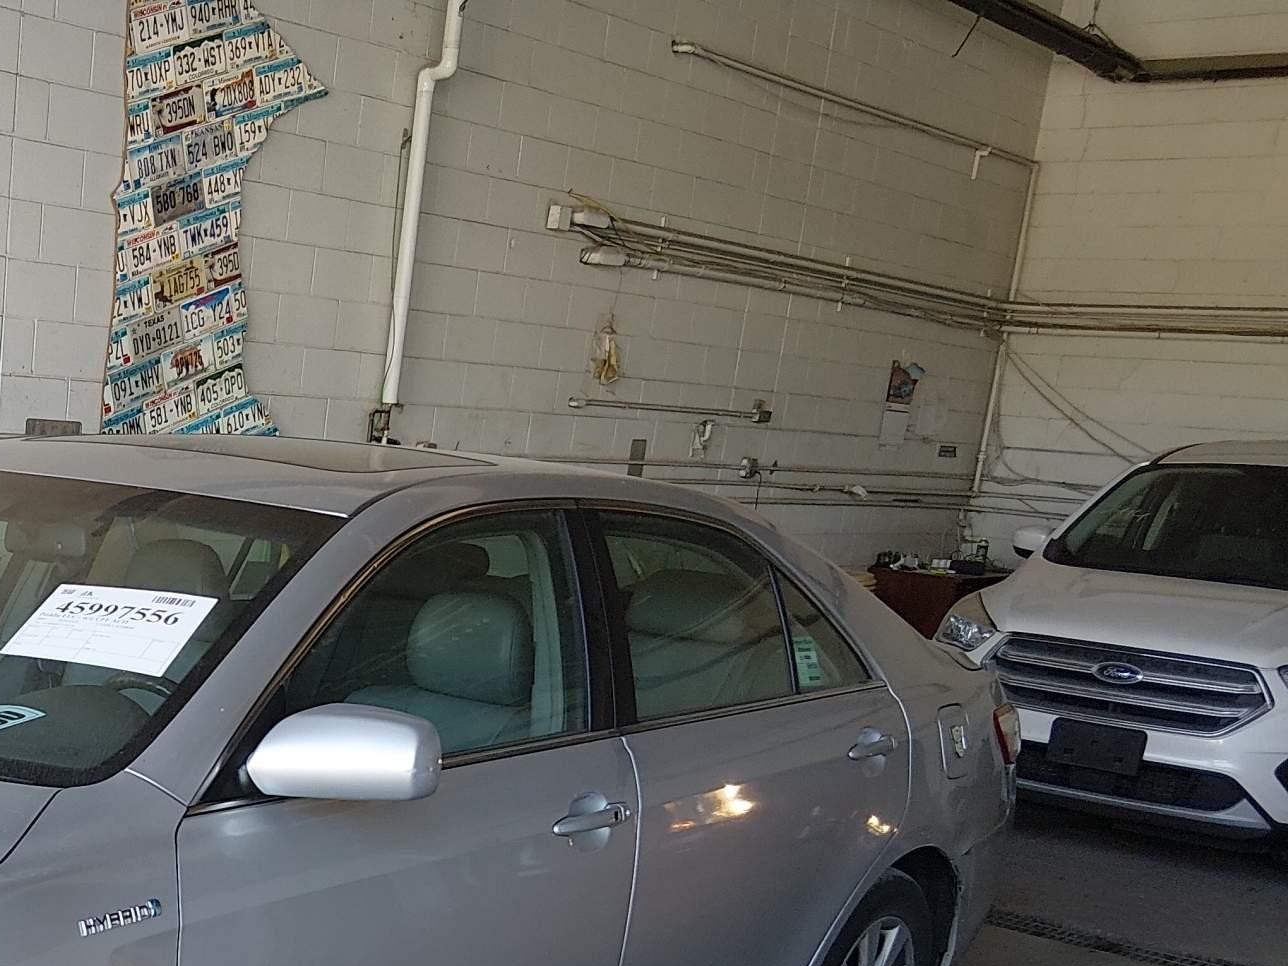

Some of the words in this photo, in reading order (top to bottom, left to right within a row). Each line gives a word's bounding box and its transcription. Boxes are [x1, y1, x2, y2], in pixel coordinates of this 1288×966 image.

[144, 315, 165, 328] TEXAS
[56, 600, 184, 627] 45997556
[78, 901, 155, 937] HYBRID
